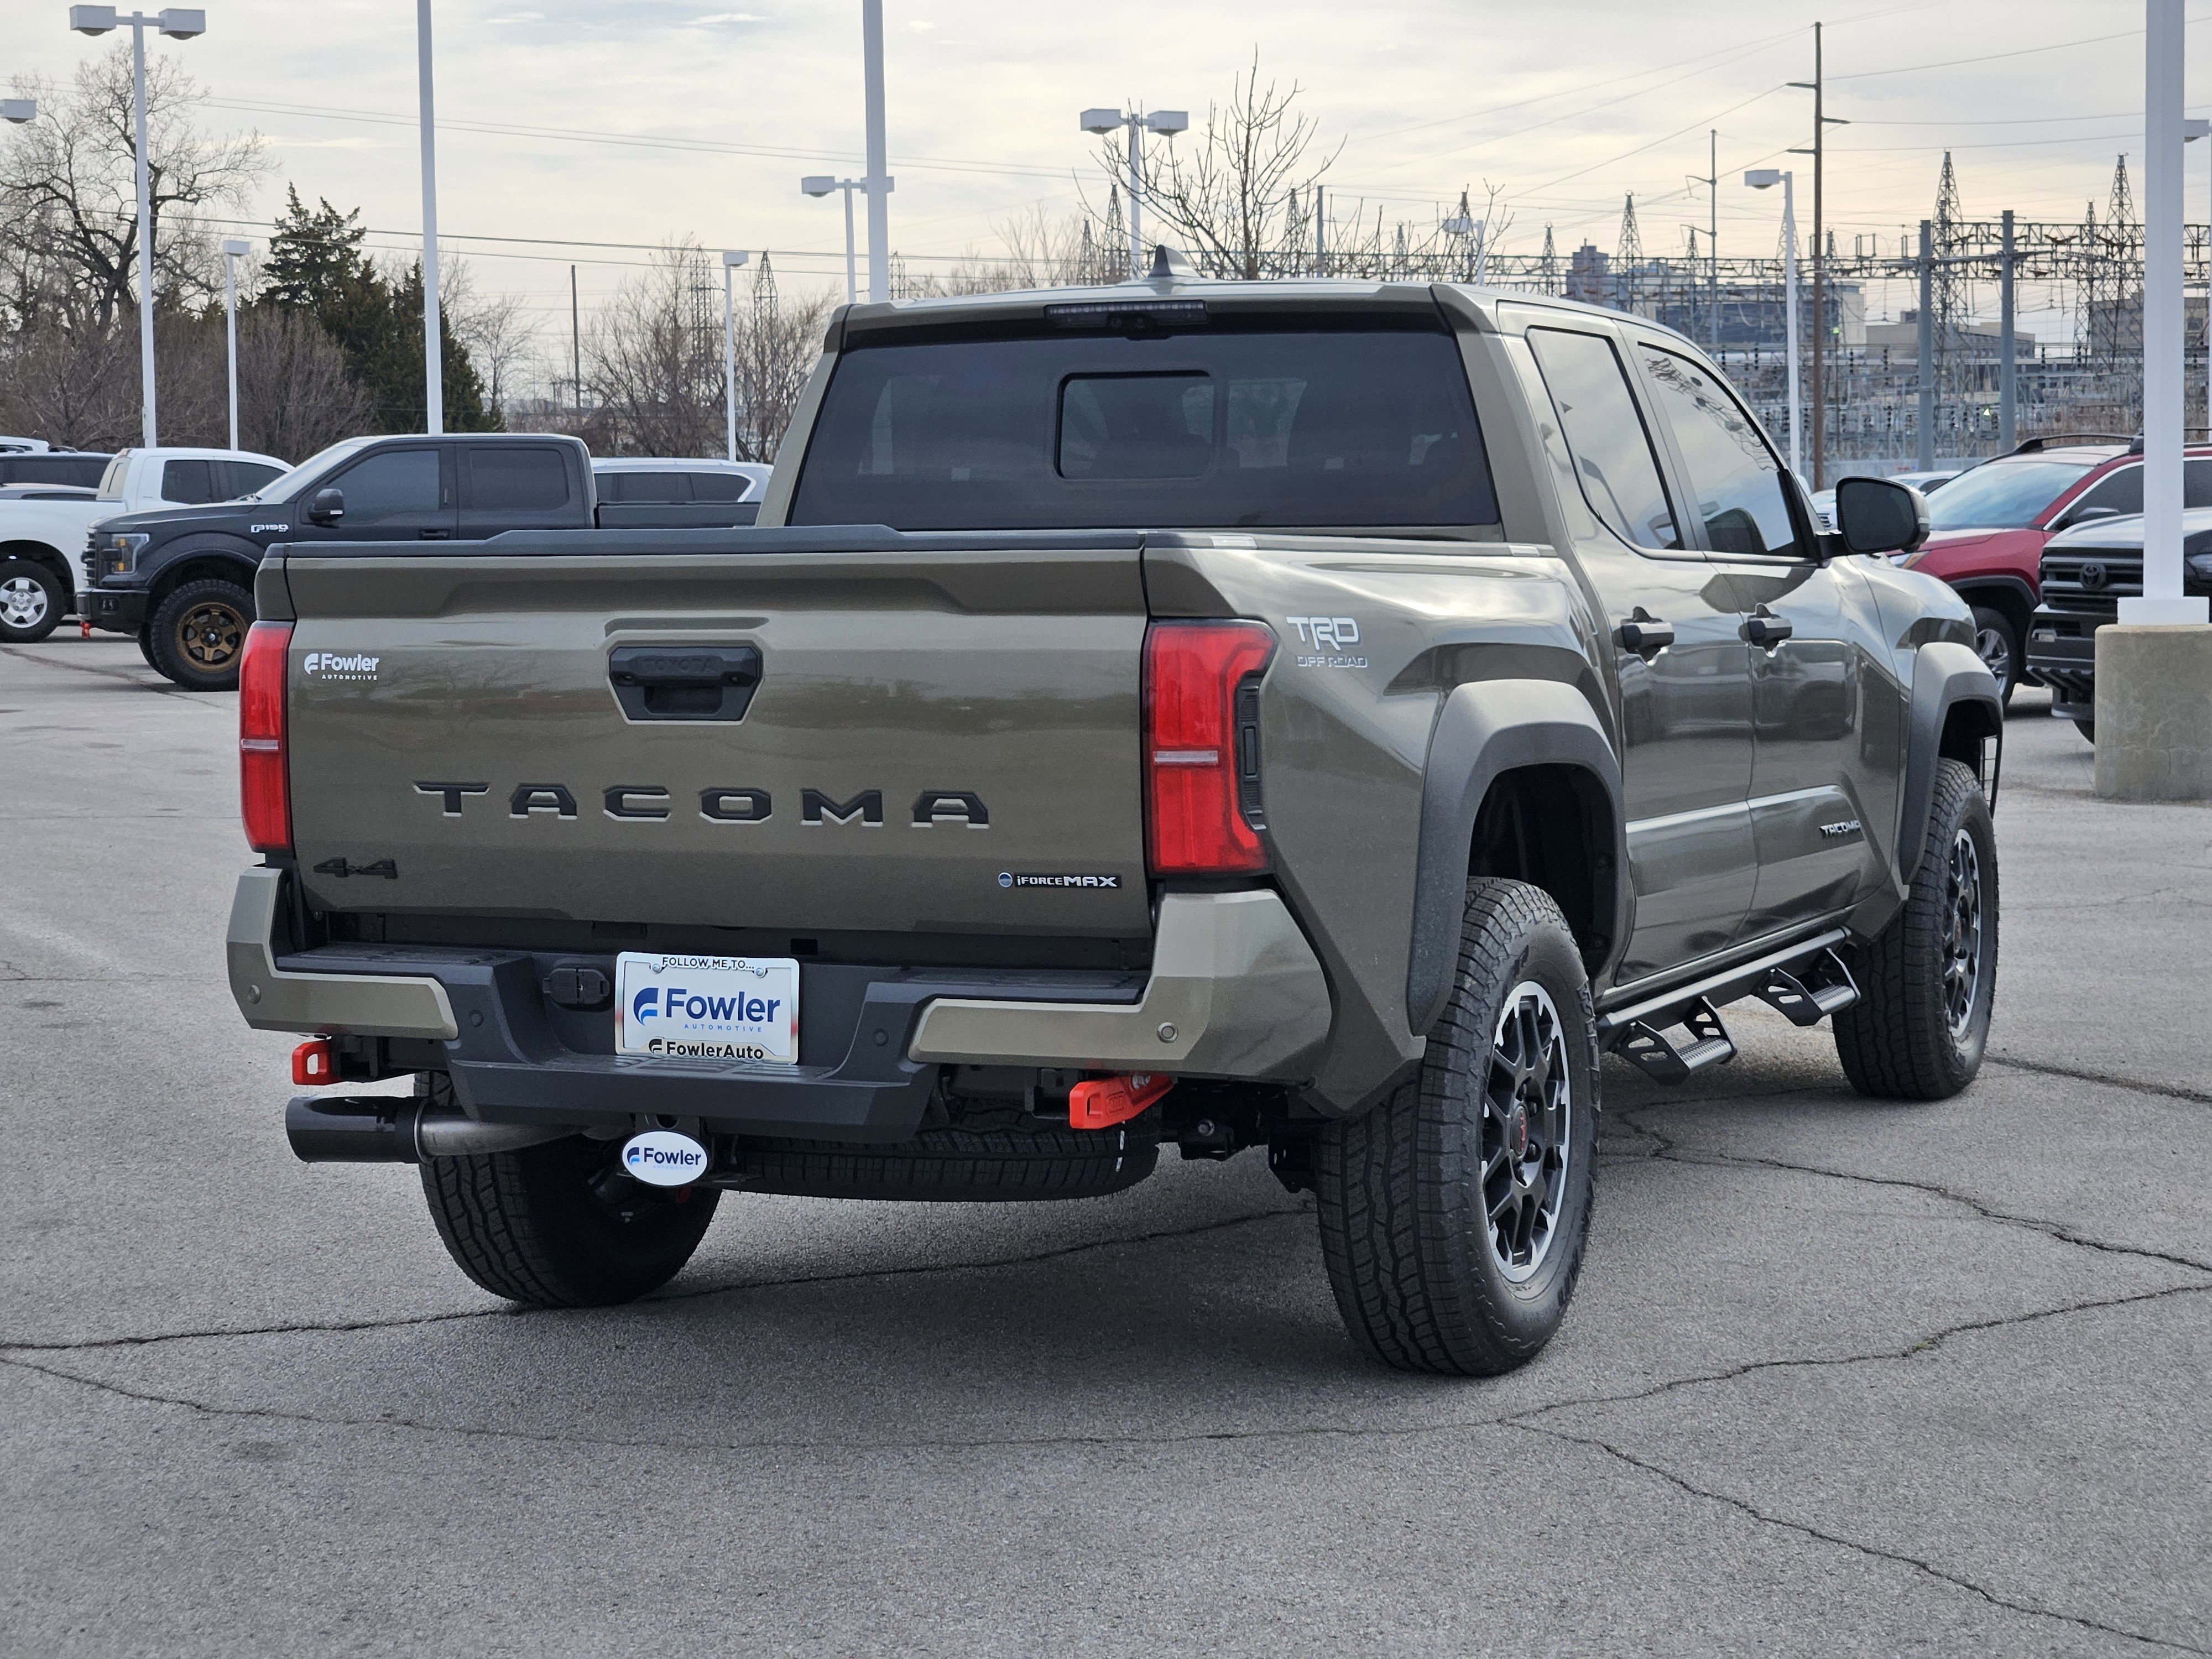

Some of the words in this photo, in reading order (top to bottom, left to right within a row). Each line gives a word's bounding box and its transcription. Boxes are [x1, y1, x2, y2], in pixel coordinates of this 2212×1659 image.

[1286, 617, 1359, 650] TRD
[321, 653, 379, 671] Fowler
[1297, 655, 1325, 667] OFF
[1328, 655, 1368, 668] ROAD
[413, 781, 990, 828] TACOMA
[1819, 820, 1861, 835] TACOMA
[662, 957, 708, 967] FOLLOW
[712, 959, 727, 968] ME
[666, 988, 780, 1022] Fowler
[684, 1024, 761, 1032] AUTOMOTIVE
[666, 1041, 764, 1060] FowlerAuto
[644, 1147, 701, 1165] Fowler
